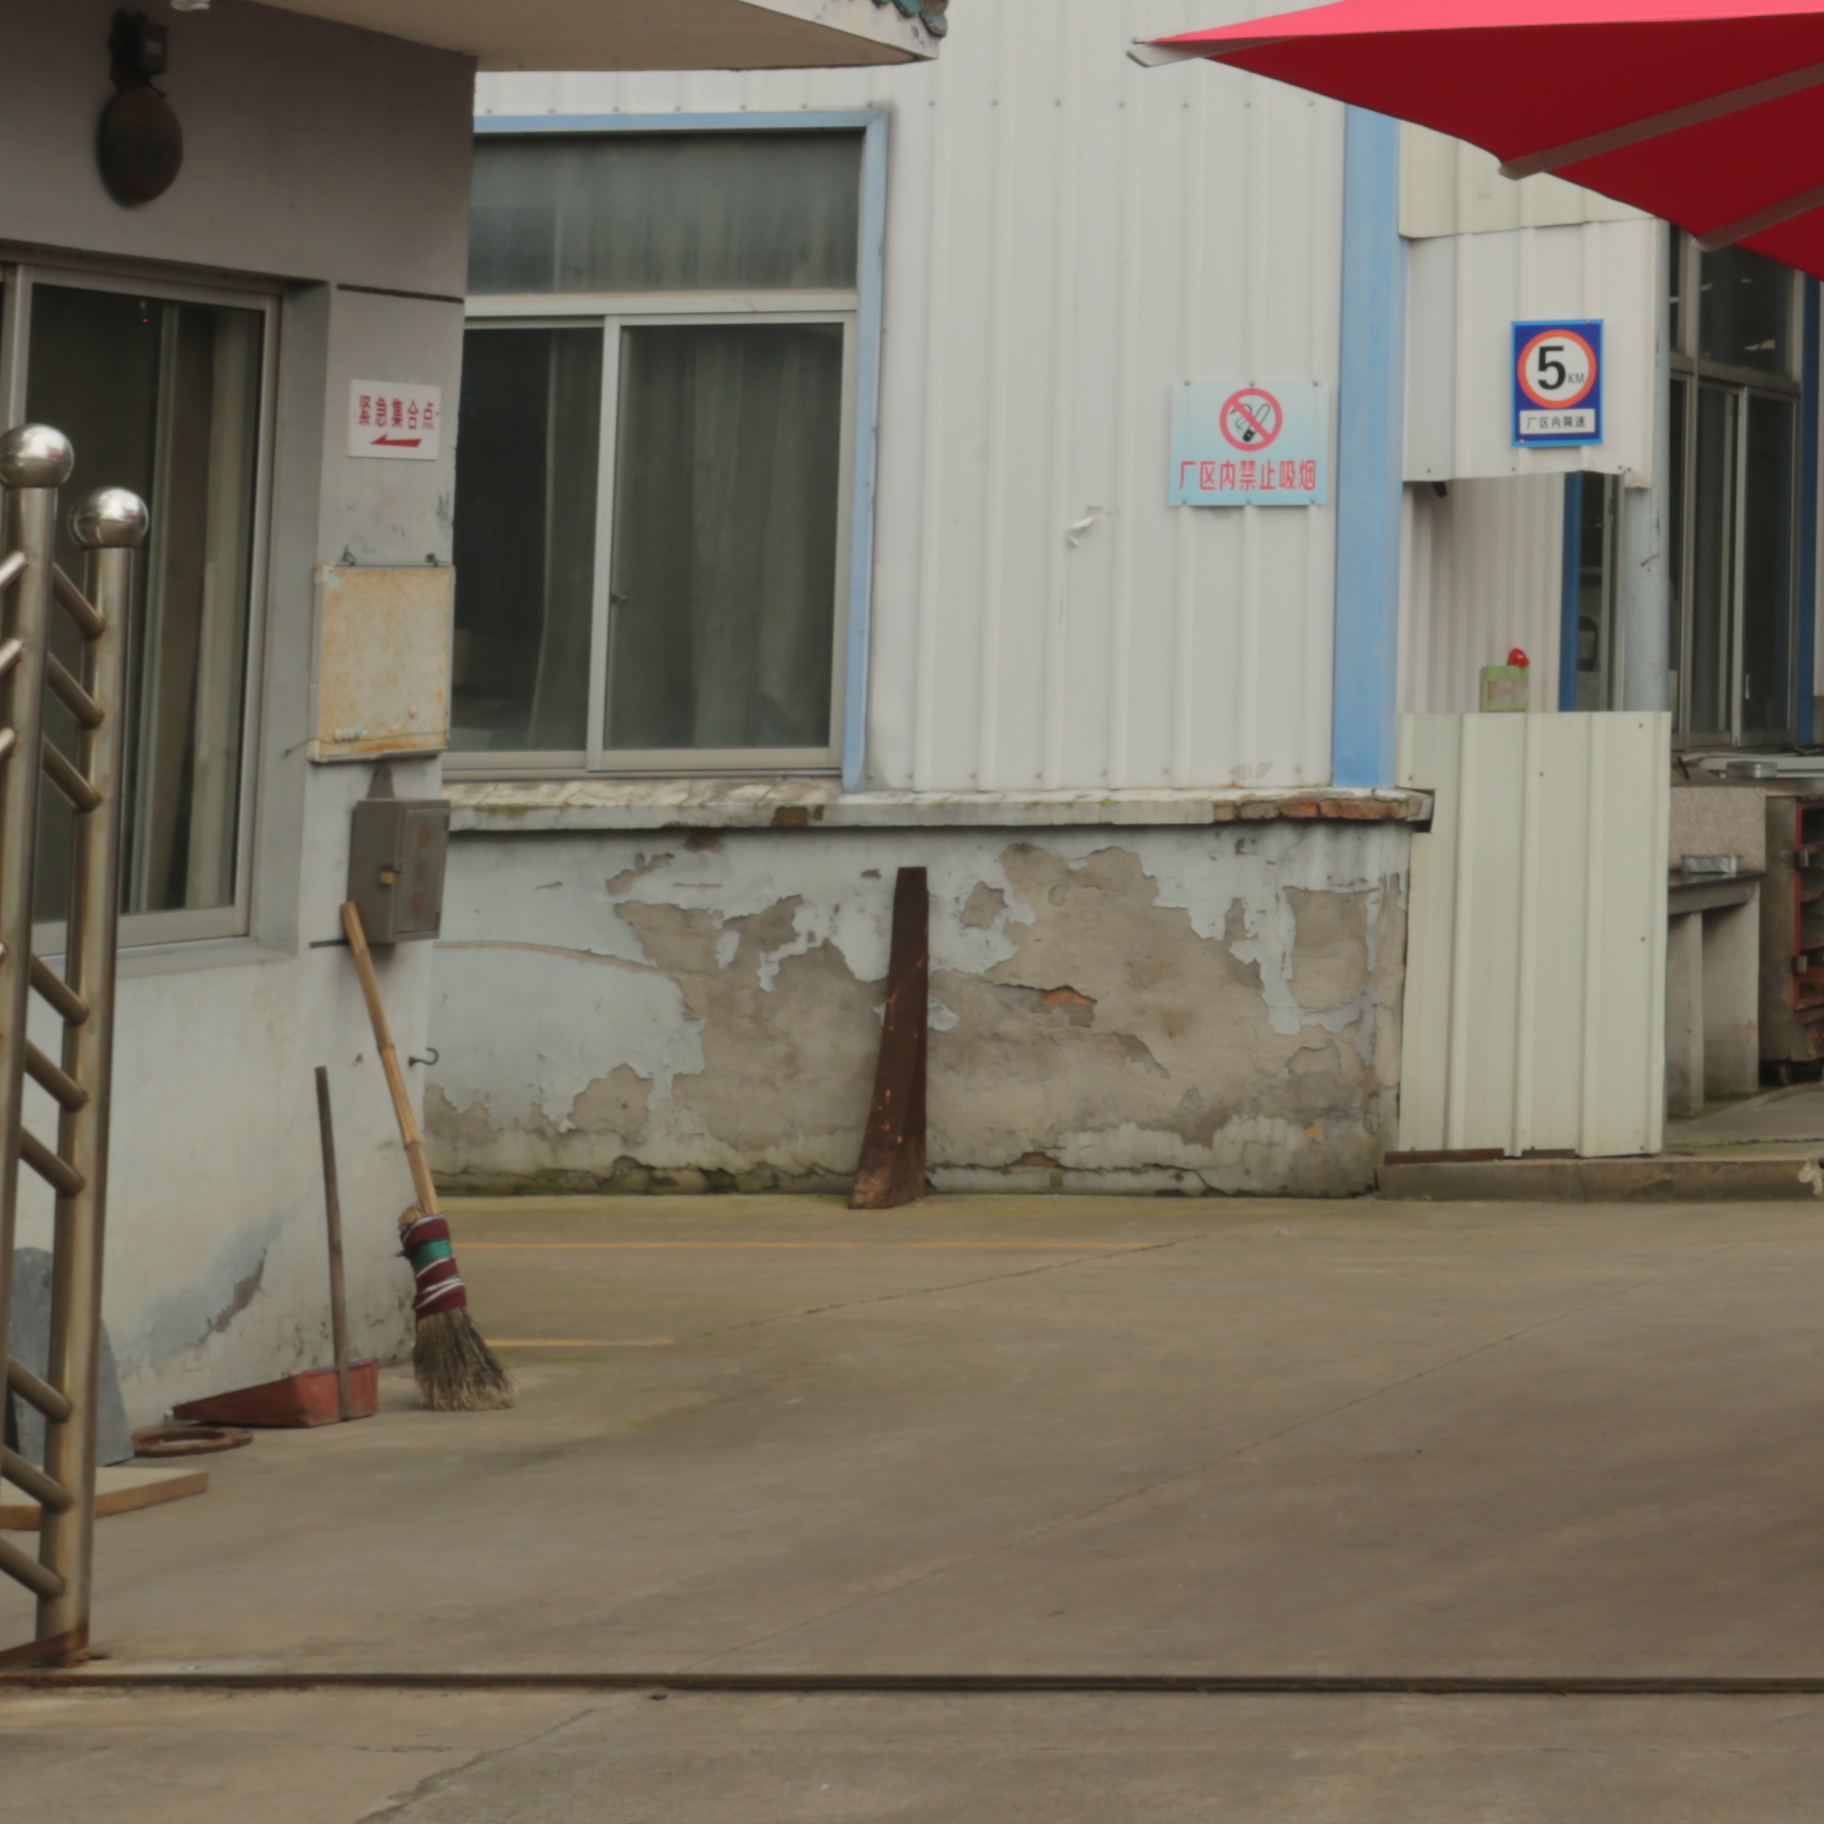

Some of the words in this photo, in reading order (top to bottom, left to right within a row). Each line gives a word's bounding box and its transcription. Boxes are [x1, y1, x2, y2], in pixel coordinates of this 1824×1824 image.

[1537, 345, 1566, 390] 5
[1568, 372, 1585, 385] KM
[358, 395, 435, 430] 紧急集合点
[1526, 415, 1586, 430] 厂区内限速
[1178, 459, 1317, 493] 厂区内禁止吸烟
